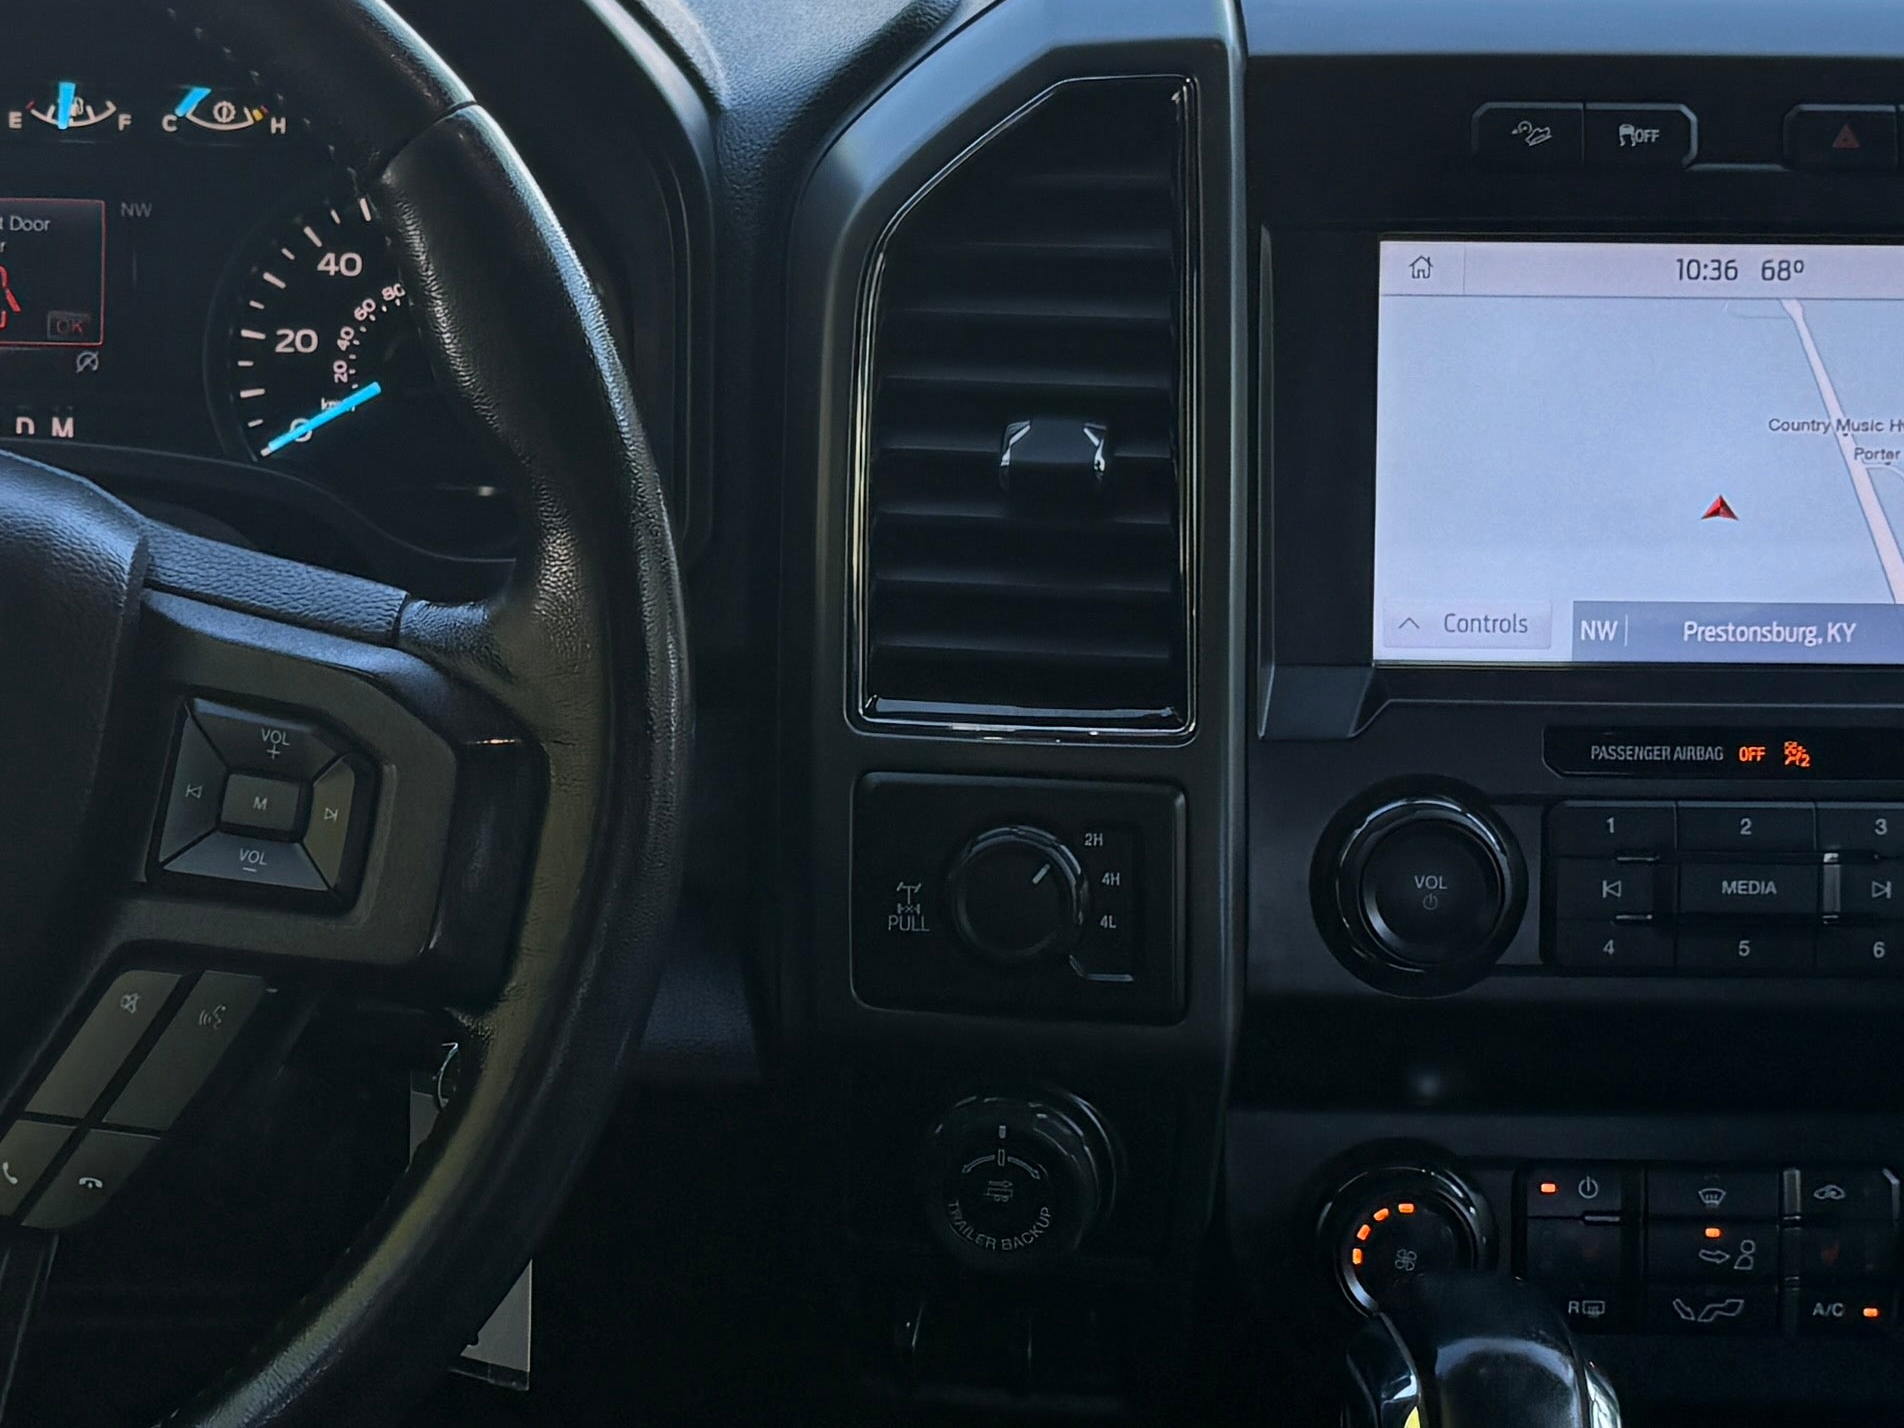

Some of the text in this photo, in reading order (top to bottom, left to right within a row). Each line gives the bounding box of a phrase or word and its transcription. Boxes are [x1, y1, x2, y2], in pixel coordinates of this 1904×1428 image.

[9, 113, 132, 130] E F
[162, 115, 286, 134] C H
[1635, 127, 1660, 143] OFF
[121, 202, 152, 217] NW
[10, 215, 51, 232] Door
[316, 251, 363, 277] 40
[1675, 257, 1739, 281] 10:36
[381, 282, 406, 302] 80
[353, 297, 377, 322] 60
[274, 327, 319, 354] 20
[336, 325, 355, 352] 40
[332, 359, 348, 384] 20
[51, 416, 74, 439] M
[1767, 417, 1832, 434] Country
[1835, 417, 1884, 433] Music
[1853, 446, 1900, 461] Porter
[1443, 612, 1528, 635] Controls
[1580, 620, 1857, 646] NW Prestonsburg, KY
[260, 727, 291, 747] VOL
[1590, 745, 1767, 763] PASSENGER AIRBAG OFF
[252, 796, 268, 811] M
[1606, 817, 1888, 836] 1 2 3
[1083, 832, 1104, 847] 2H
[239, 847, 268, 866] VOL
[1100, 872, 1121, 886] 4H
[1414, 875, 1448, 890] VOL
[1721, 880, 1777, 896] MEDIA
[887, 914, 931, 932] PULL
[1099, 915, 1118, 929] 4L
[1603, 939, 1886, 959] 4 5 6
[947, 1198, 1052, 1251] TRAILER BACKUP
[1567, 1300, 1580, 1315] R
[1812, 1300, 1845, 1317] A/C
